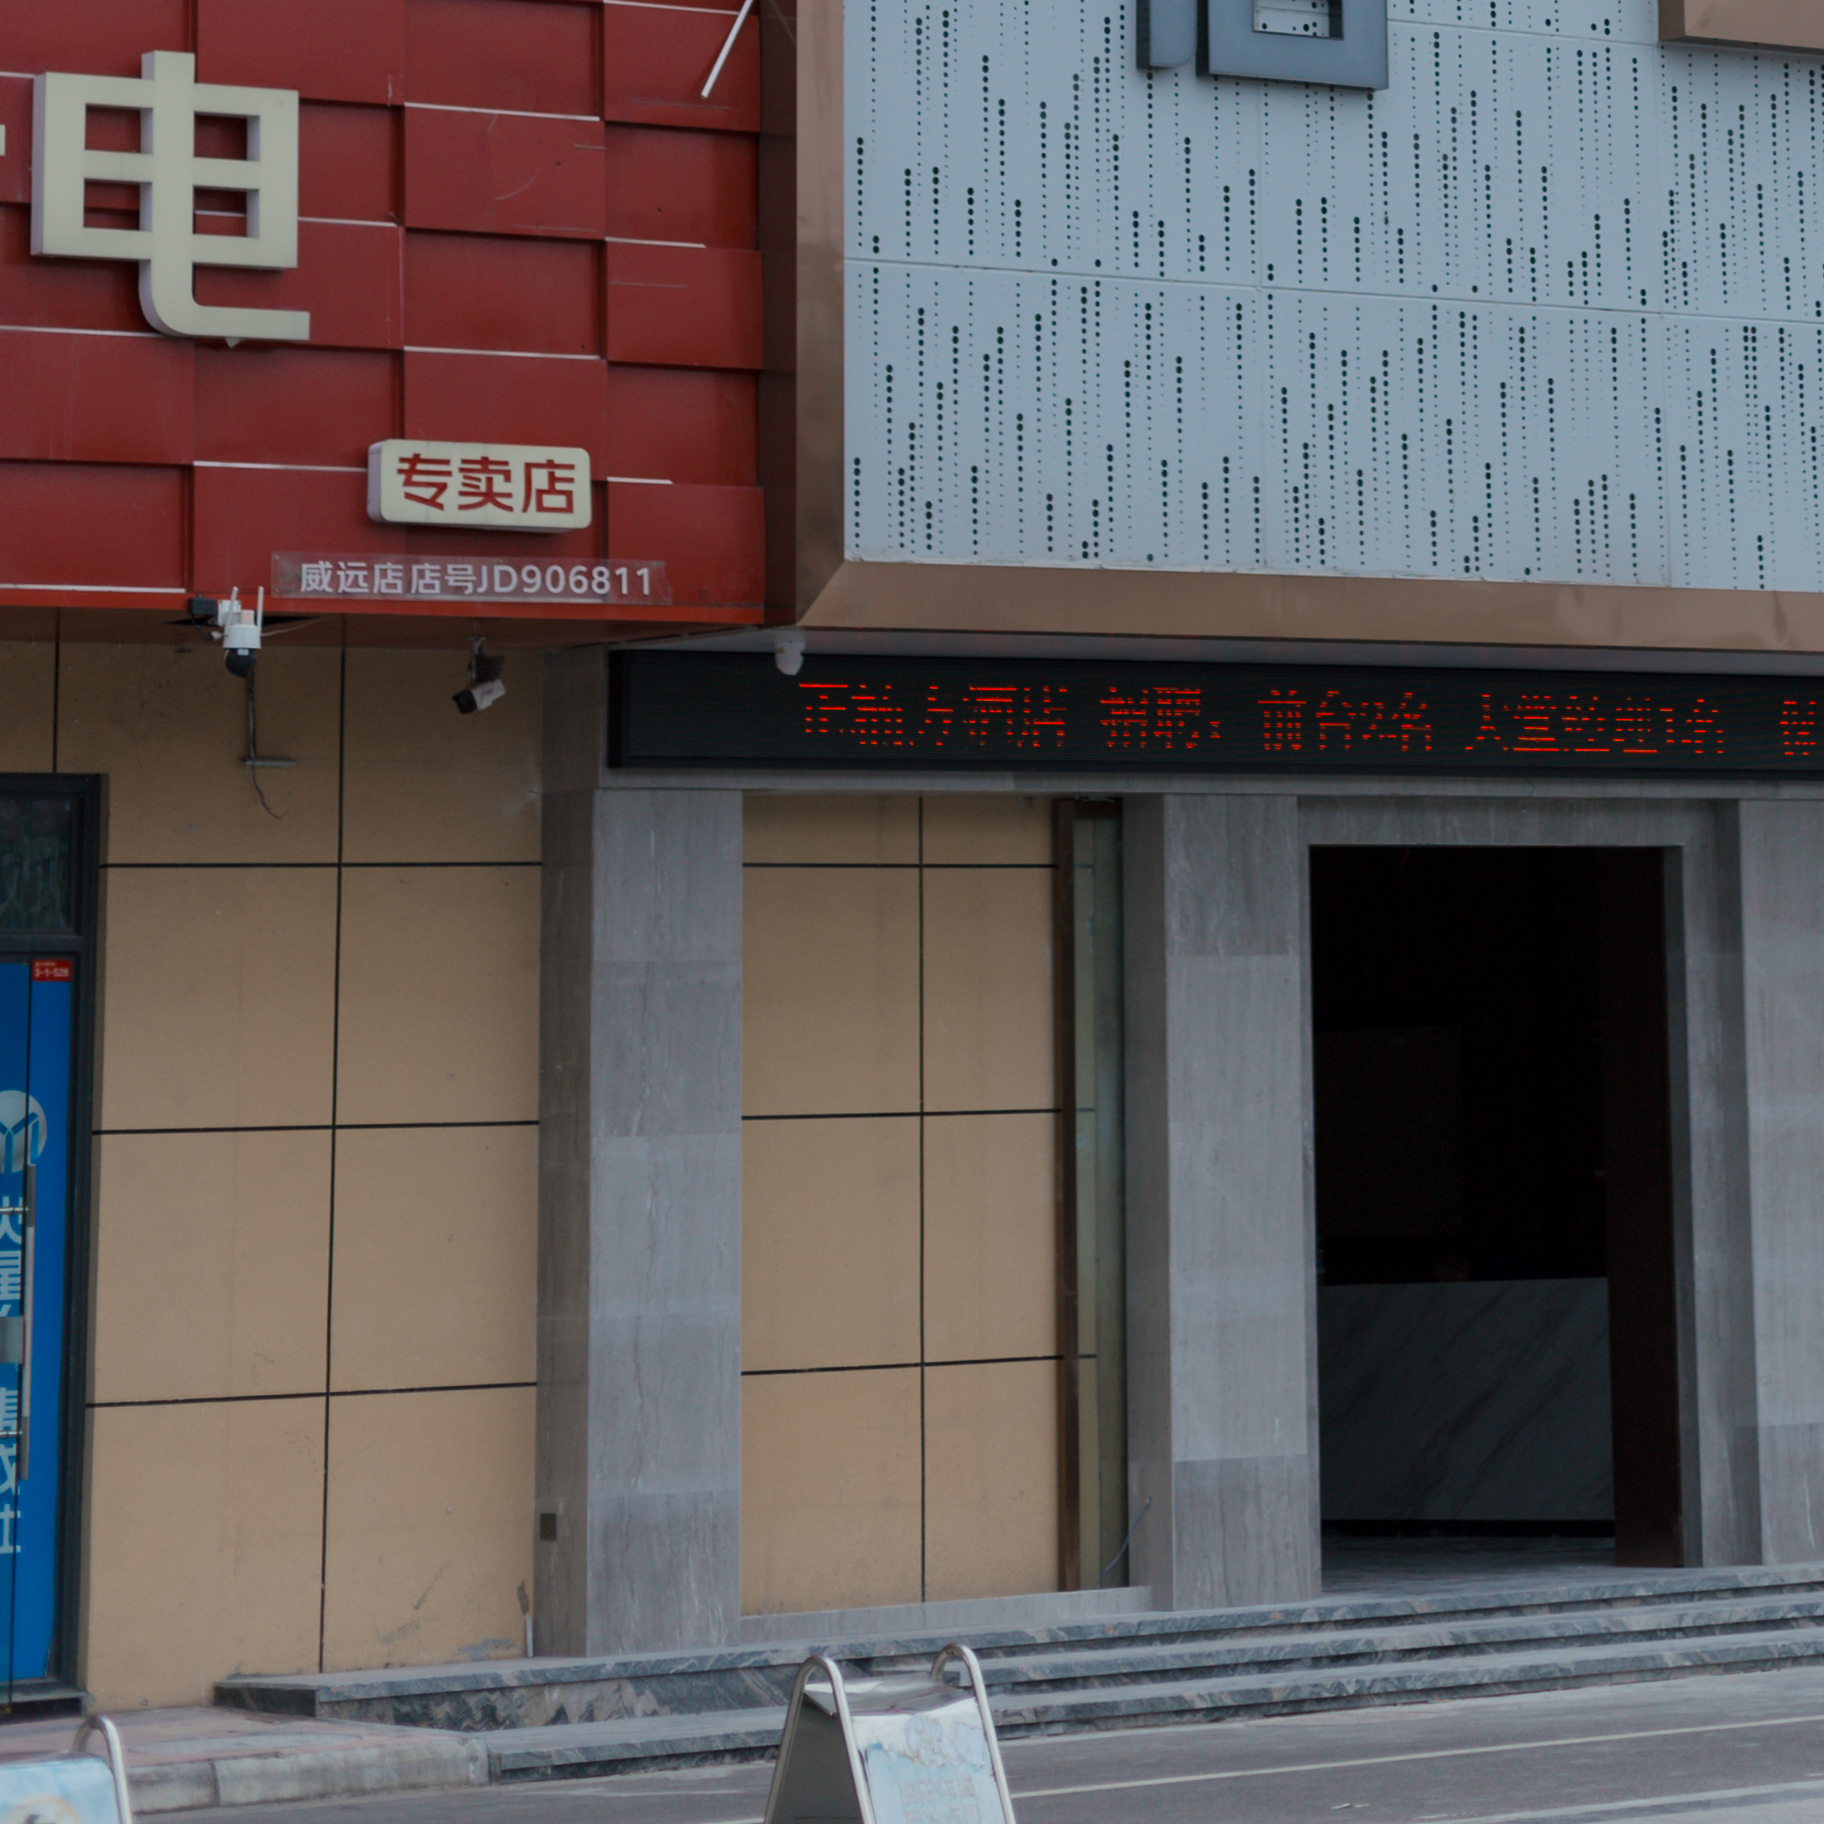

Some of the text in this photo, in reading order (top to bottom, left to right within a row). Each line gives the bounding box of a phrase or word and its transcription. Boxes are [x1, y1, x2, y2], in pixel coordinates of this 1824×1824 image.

[0, 50, 310, 344] 电
[396, 452, 577, 516] 专卖店
